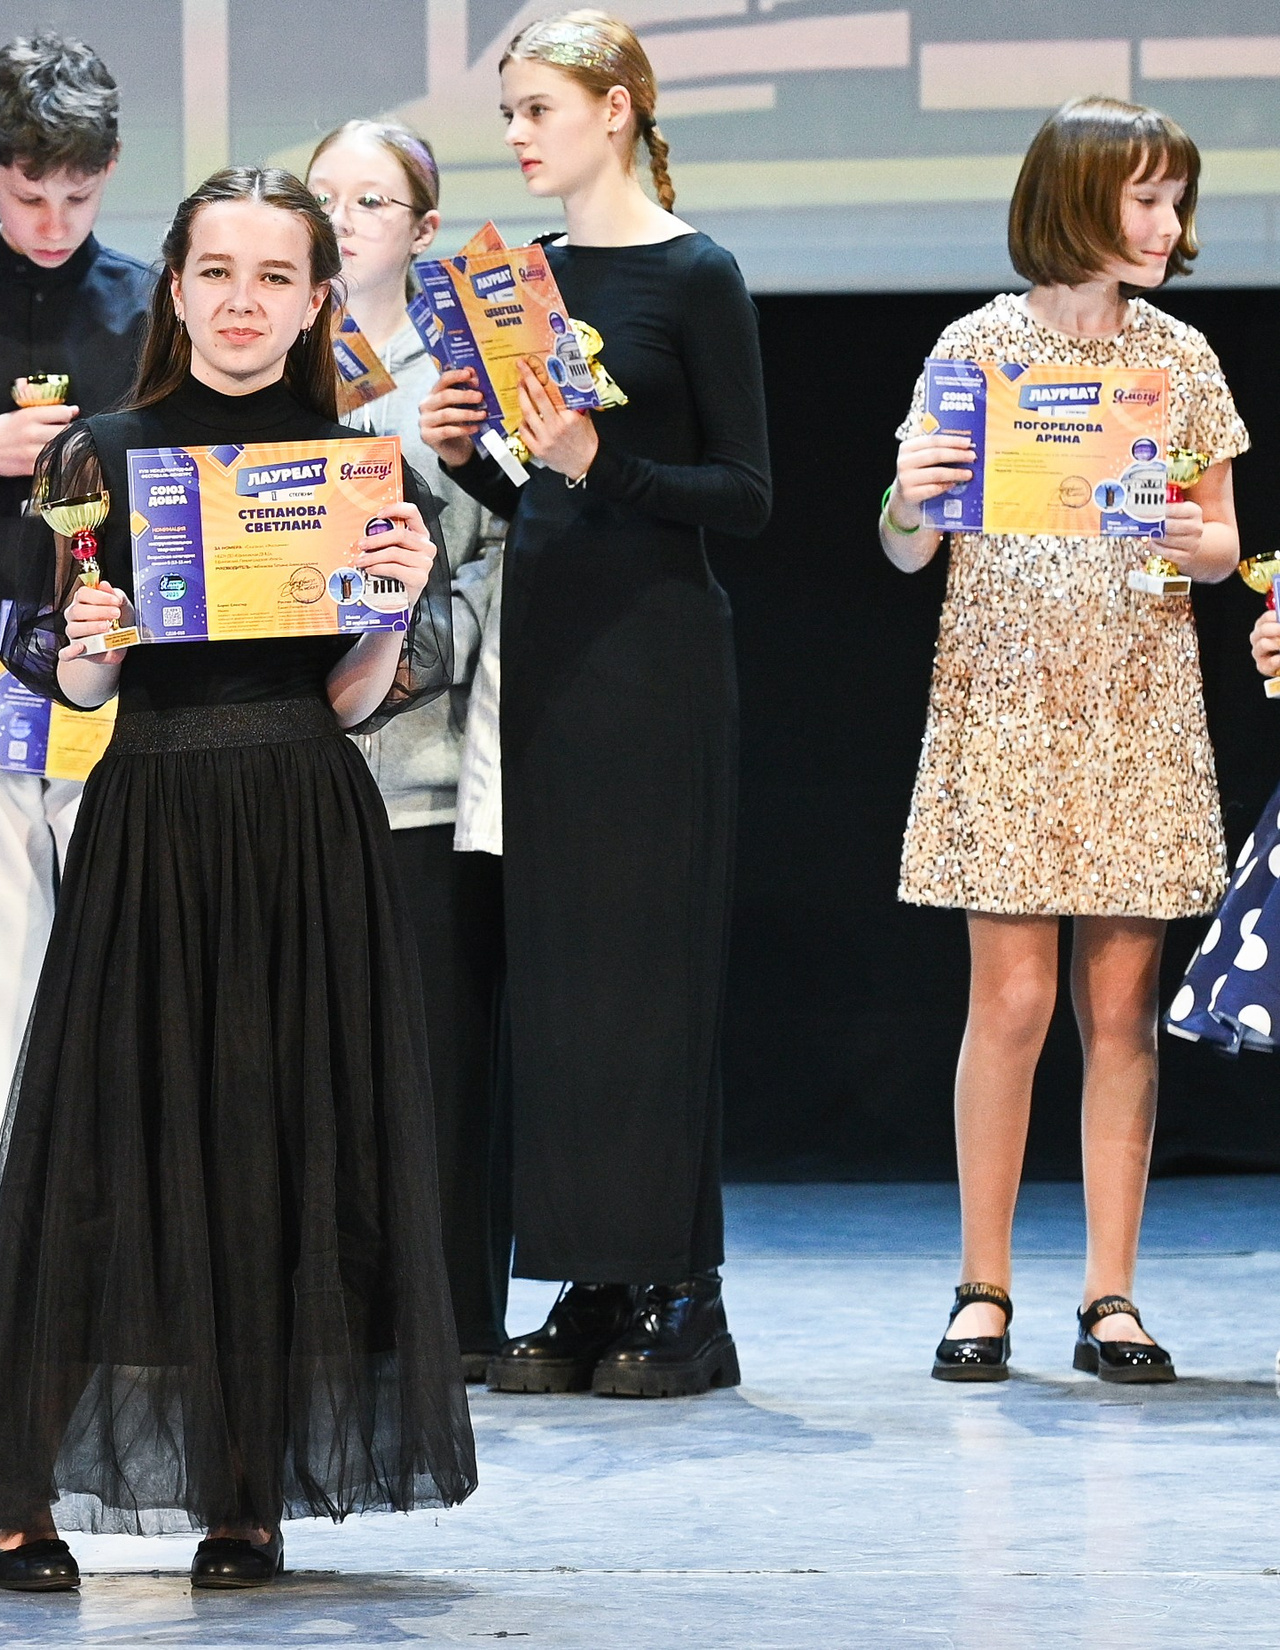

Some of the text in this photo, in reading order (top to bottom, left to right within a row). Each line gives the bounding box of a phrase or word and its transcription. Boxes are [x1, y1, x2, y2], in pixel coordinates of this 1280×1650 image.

[476, 269, 512, 290] ЛАУРЕАТ
[495, 316, 522, 327] МАРИЯ
[1029, 386, 1098, 402] ЛАУРЕАТ
[1014, 421, 1103, 432] ПОГОРЕЛОВА
[1036, 434, 1081, 443] АРИНА
[248, 464, 323, 487] ЛАУРЕАТ
[150, 485, 184, 495] СОЮЗ
[148, 495, 188, 507] ДОБРА
[238, 506, 327, 520] СТЕПАНОВА
[245, 520, 322, 533] СВЕТЛАНА
